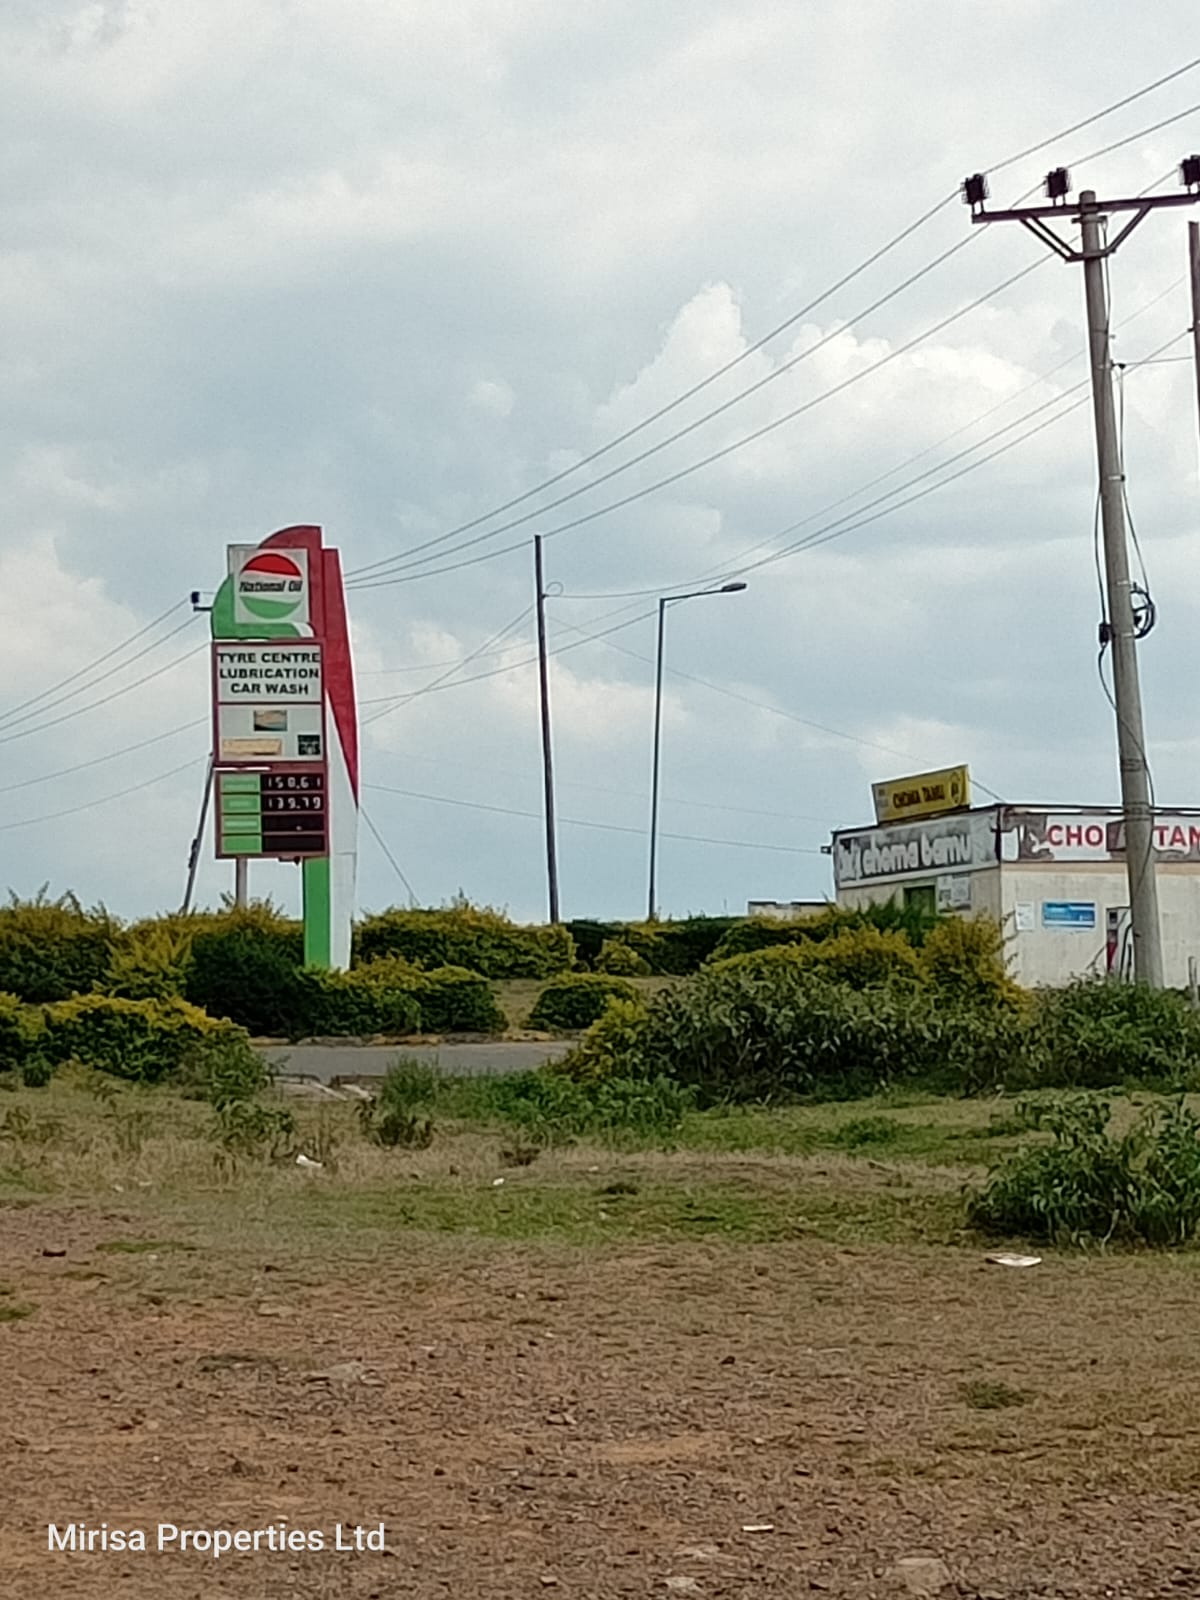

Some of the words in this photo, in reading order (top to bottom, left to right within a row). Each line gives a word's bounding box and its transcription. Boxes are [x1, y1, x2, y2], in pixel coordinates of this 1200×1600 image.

[239, 580, 286, 593] National
[288, 580, 303, 593] Oil
[218, 653, 256, 664] TYRE
[261, 652, 320, 663] CENTRE
[219, 667, 319, 679] LUBRICATION
[231, 683, 261, 694] CAR
[265, 683, 309, 695] WASH
